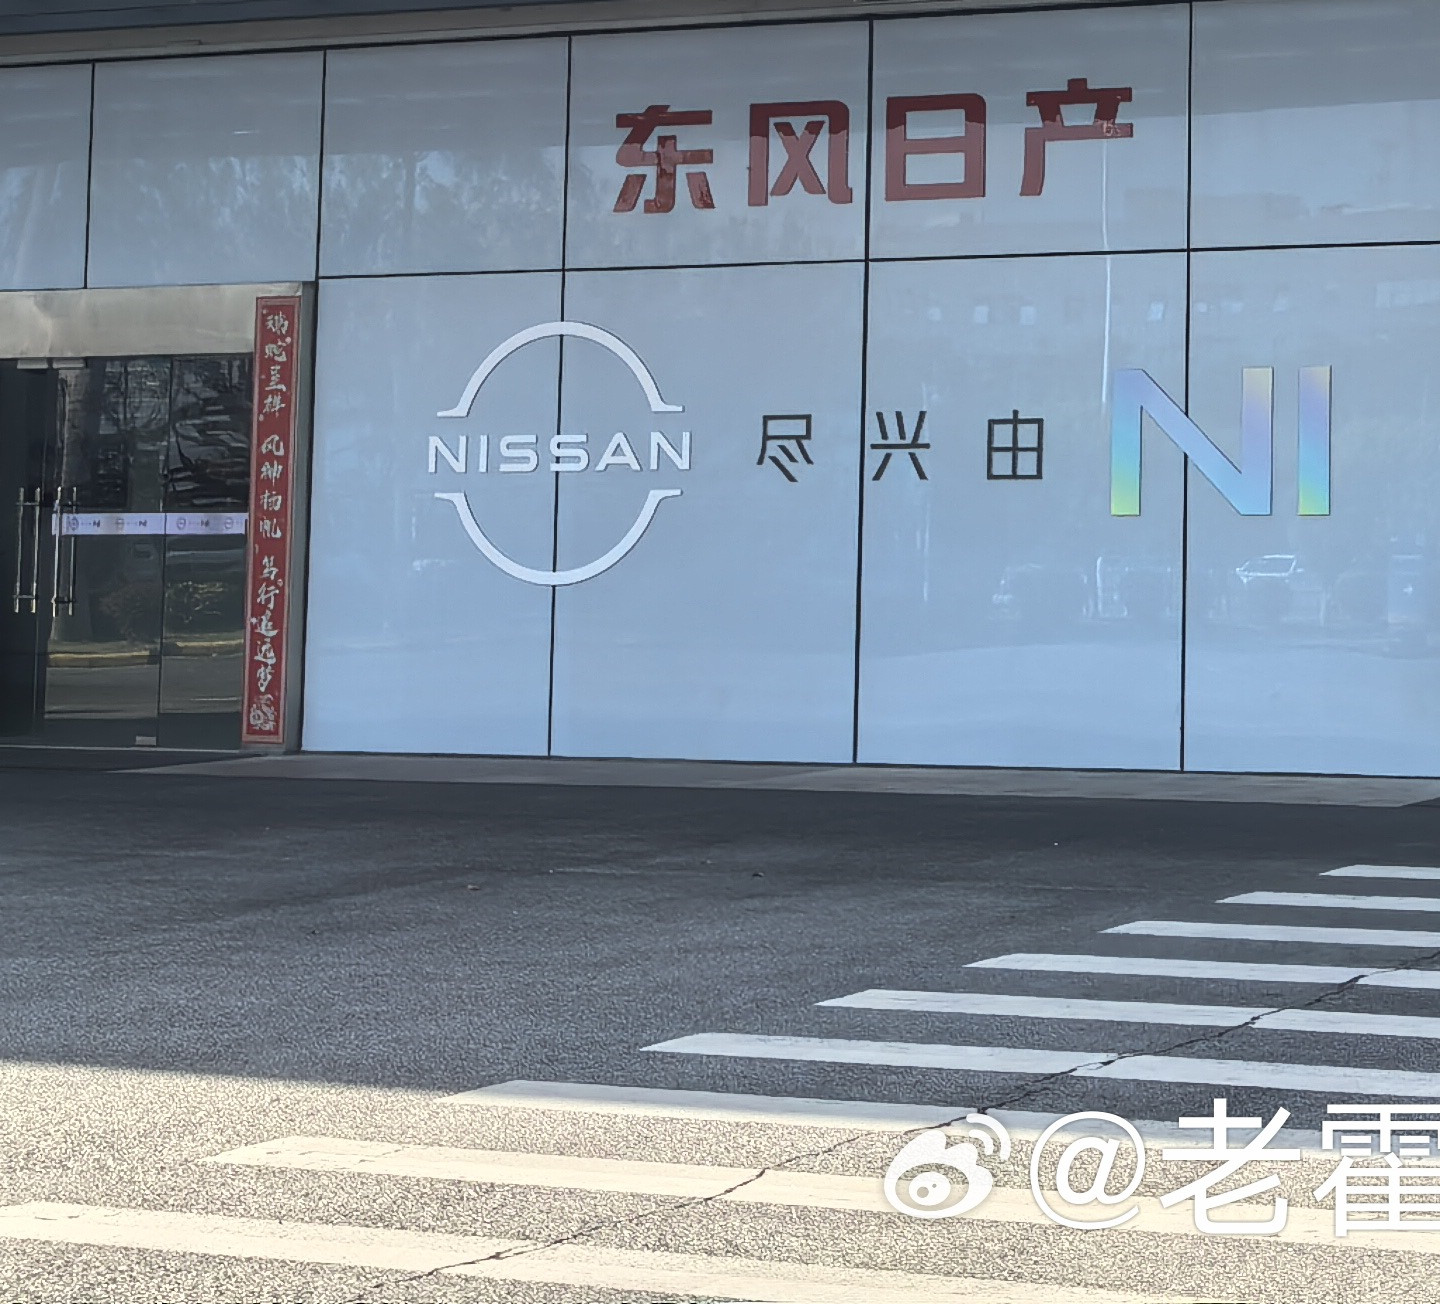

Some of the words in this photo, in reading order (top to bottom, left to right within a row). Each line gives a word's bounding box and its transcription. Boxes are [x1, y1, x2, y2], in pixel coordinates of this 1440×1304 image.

[613, 78, 1134, 214] 东风日产
[427, 431, 692, 475] NISSAN
[756, 409, 1045, 483] 尽兴由
[1109, 365, 1332, 516] NI
